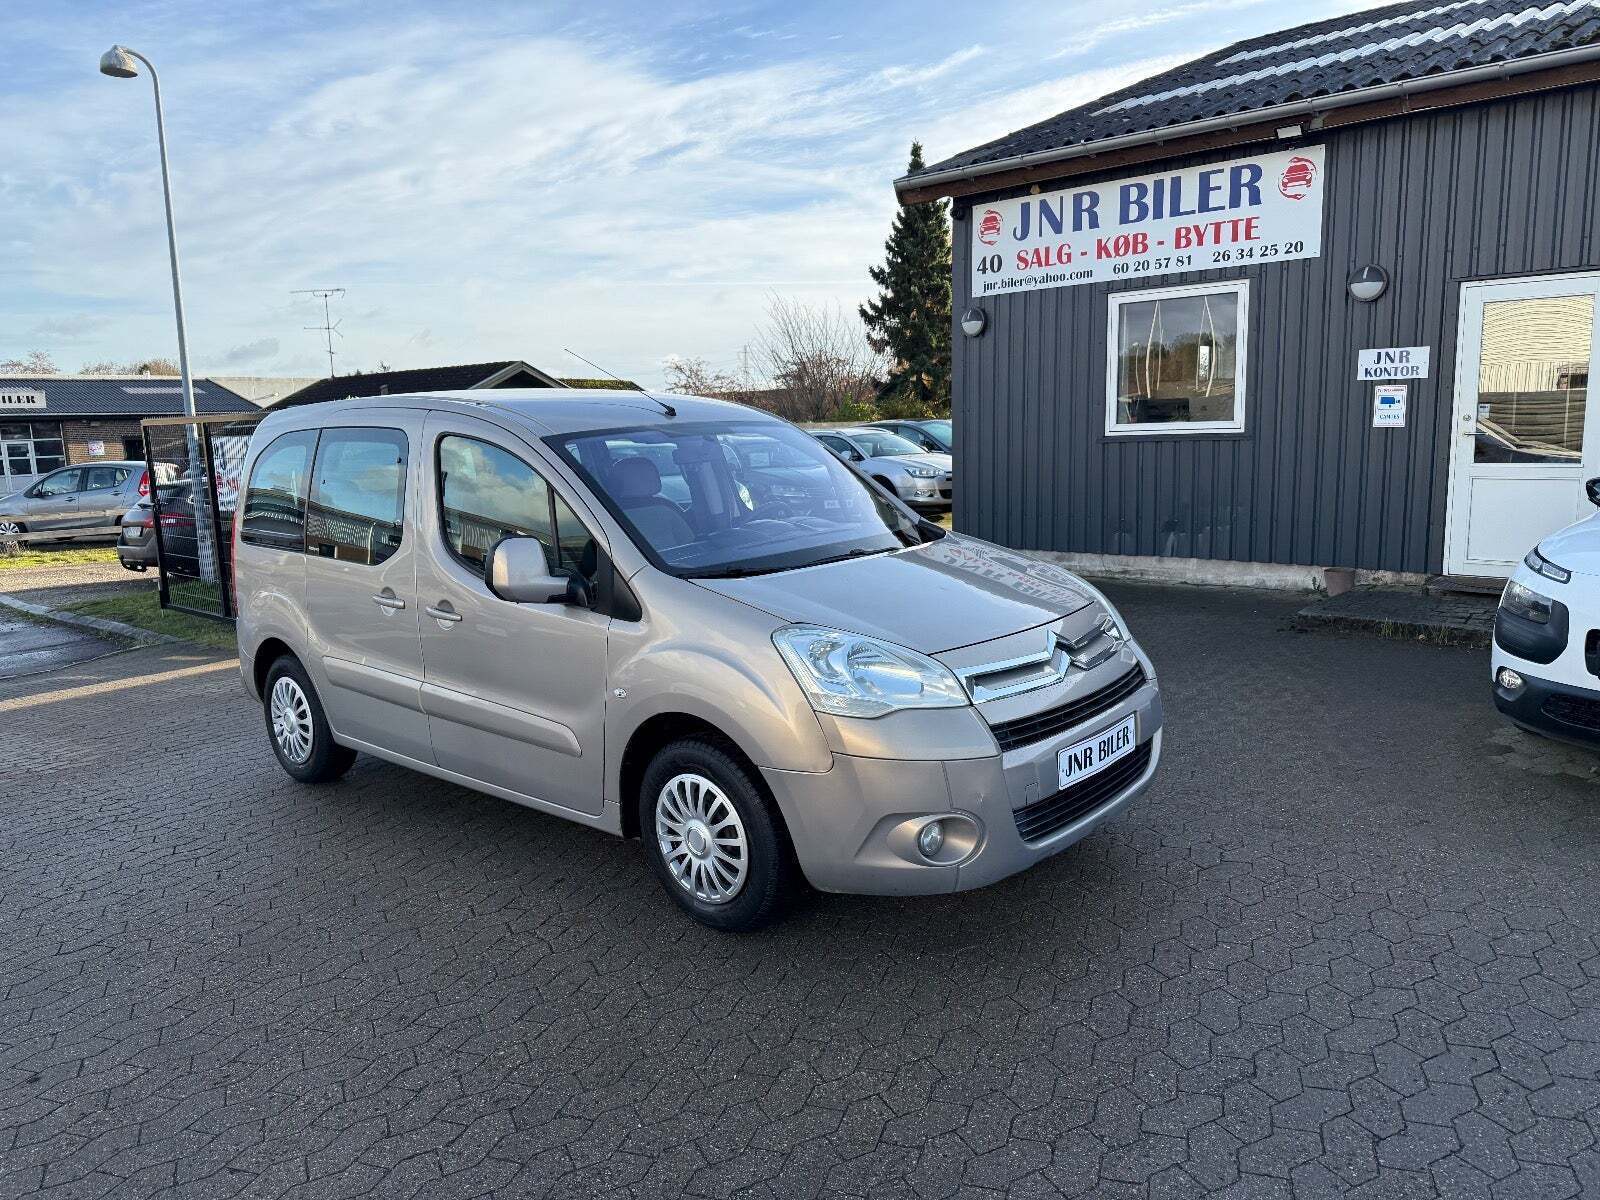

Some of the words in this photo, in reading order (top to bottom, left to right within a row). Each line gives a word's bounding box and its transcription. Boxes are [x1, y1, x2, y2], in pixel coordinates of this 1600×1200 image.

[1012, 190, 1100, 242] JNR
[1119, 163, 1263, 226] BILER
[1016, 243, 1073, 271] SALG
[1096, 233, 1149, 260] KØB
[1174, 216, 1261, 250] BYTTE
[1212, 249, 1231, 263] 26
[1235, 246, 1254, 260] 34
[1259, 243, 1279, 257] 25
[1284, 240, 1304, 255] 20
[976, 254, 1003, 275] 40
[1112, 262, 1130, 275] 60
[1133, 259, 1150, 272] 20
[1154, 256, 1172, 270] 57
[1175, 254, 1192, 268] 81
[982, 268, 1094, 293] jnr.biler@yahoo.com
[1373, 349, 1411, 365] JNR
[1364, 365, 1420, 378] KONTOR
[1065, 746, 1093, 777] JNR
[1098, 725, 1130, 763] BILER
